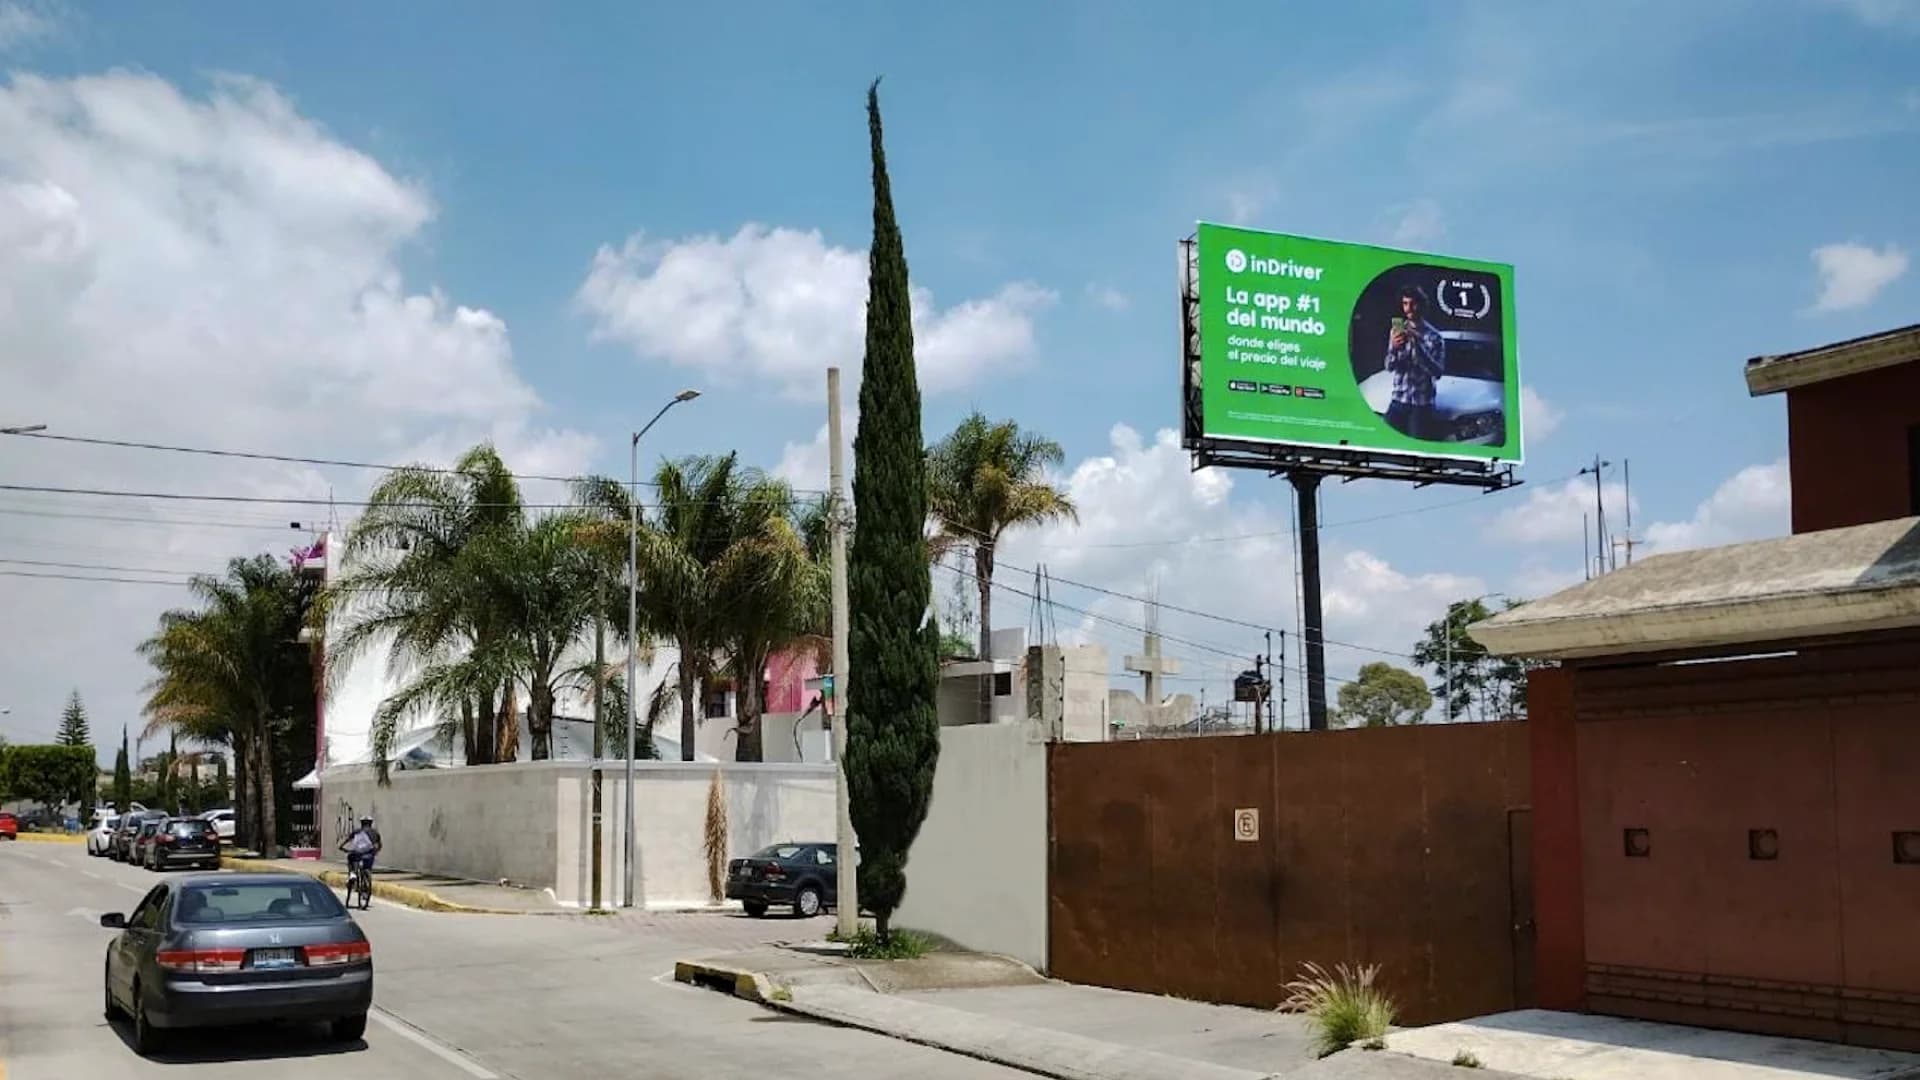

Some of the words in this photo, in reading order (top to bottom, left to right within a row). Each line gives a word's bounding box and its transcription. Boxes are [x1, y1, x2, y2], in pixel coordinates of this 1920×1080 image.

[1250, 254, 1323, 280] inDriver
[1226, 286, 1249, 305] La
[1254, 292, 1291, 314] app
[1296, 293, 1320, 313] #1
[1459, 291, 1467, 306] 1
[1226, 307, 1256, 328] del
[1261, 315, 1325, 335] mundo
[1227, 334, 1265, 349] donde
[1267, 339, 1301, 354] eliges
[1227, 349, 1239, 360] el
[1240, 351, 1277, 364] precio
[1280, 354, 1298, 366] del
[1300, 356, 1327, 372] viaje
